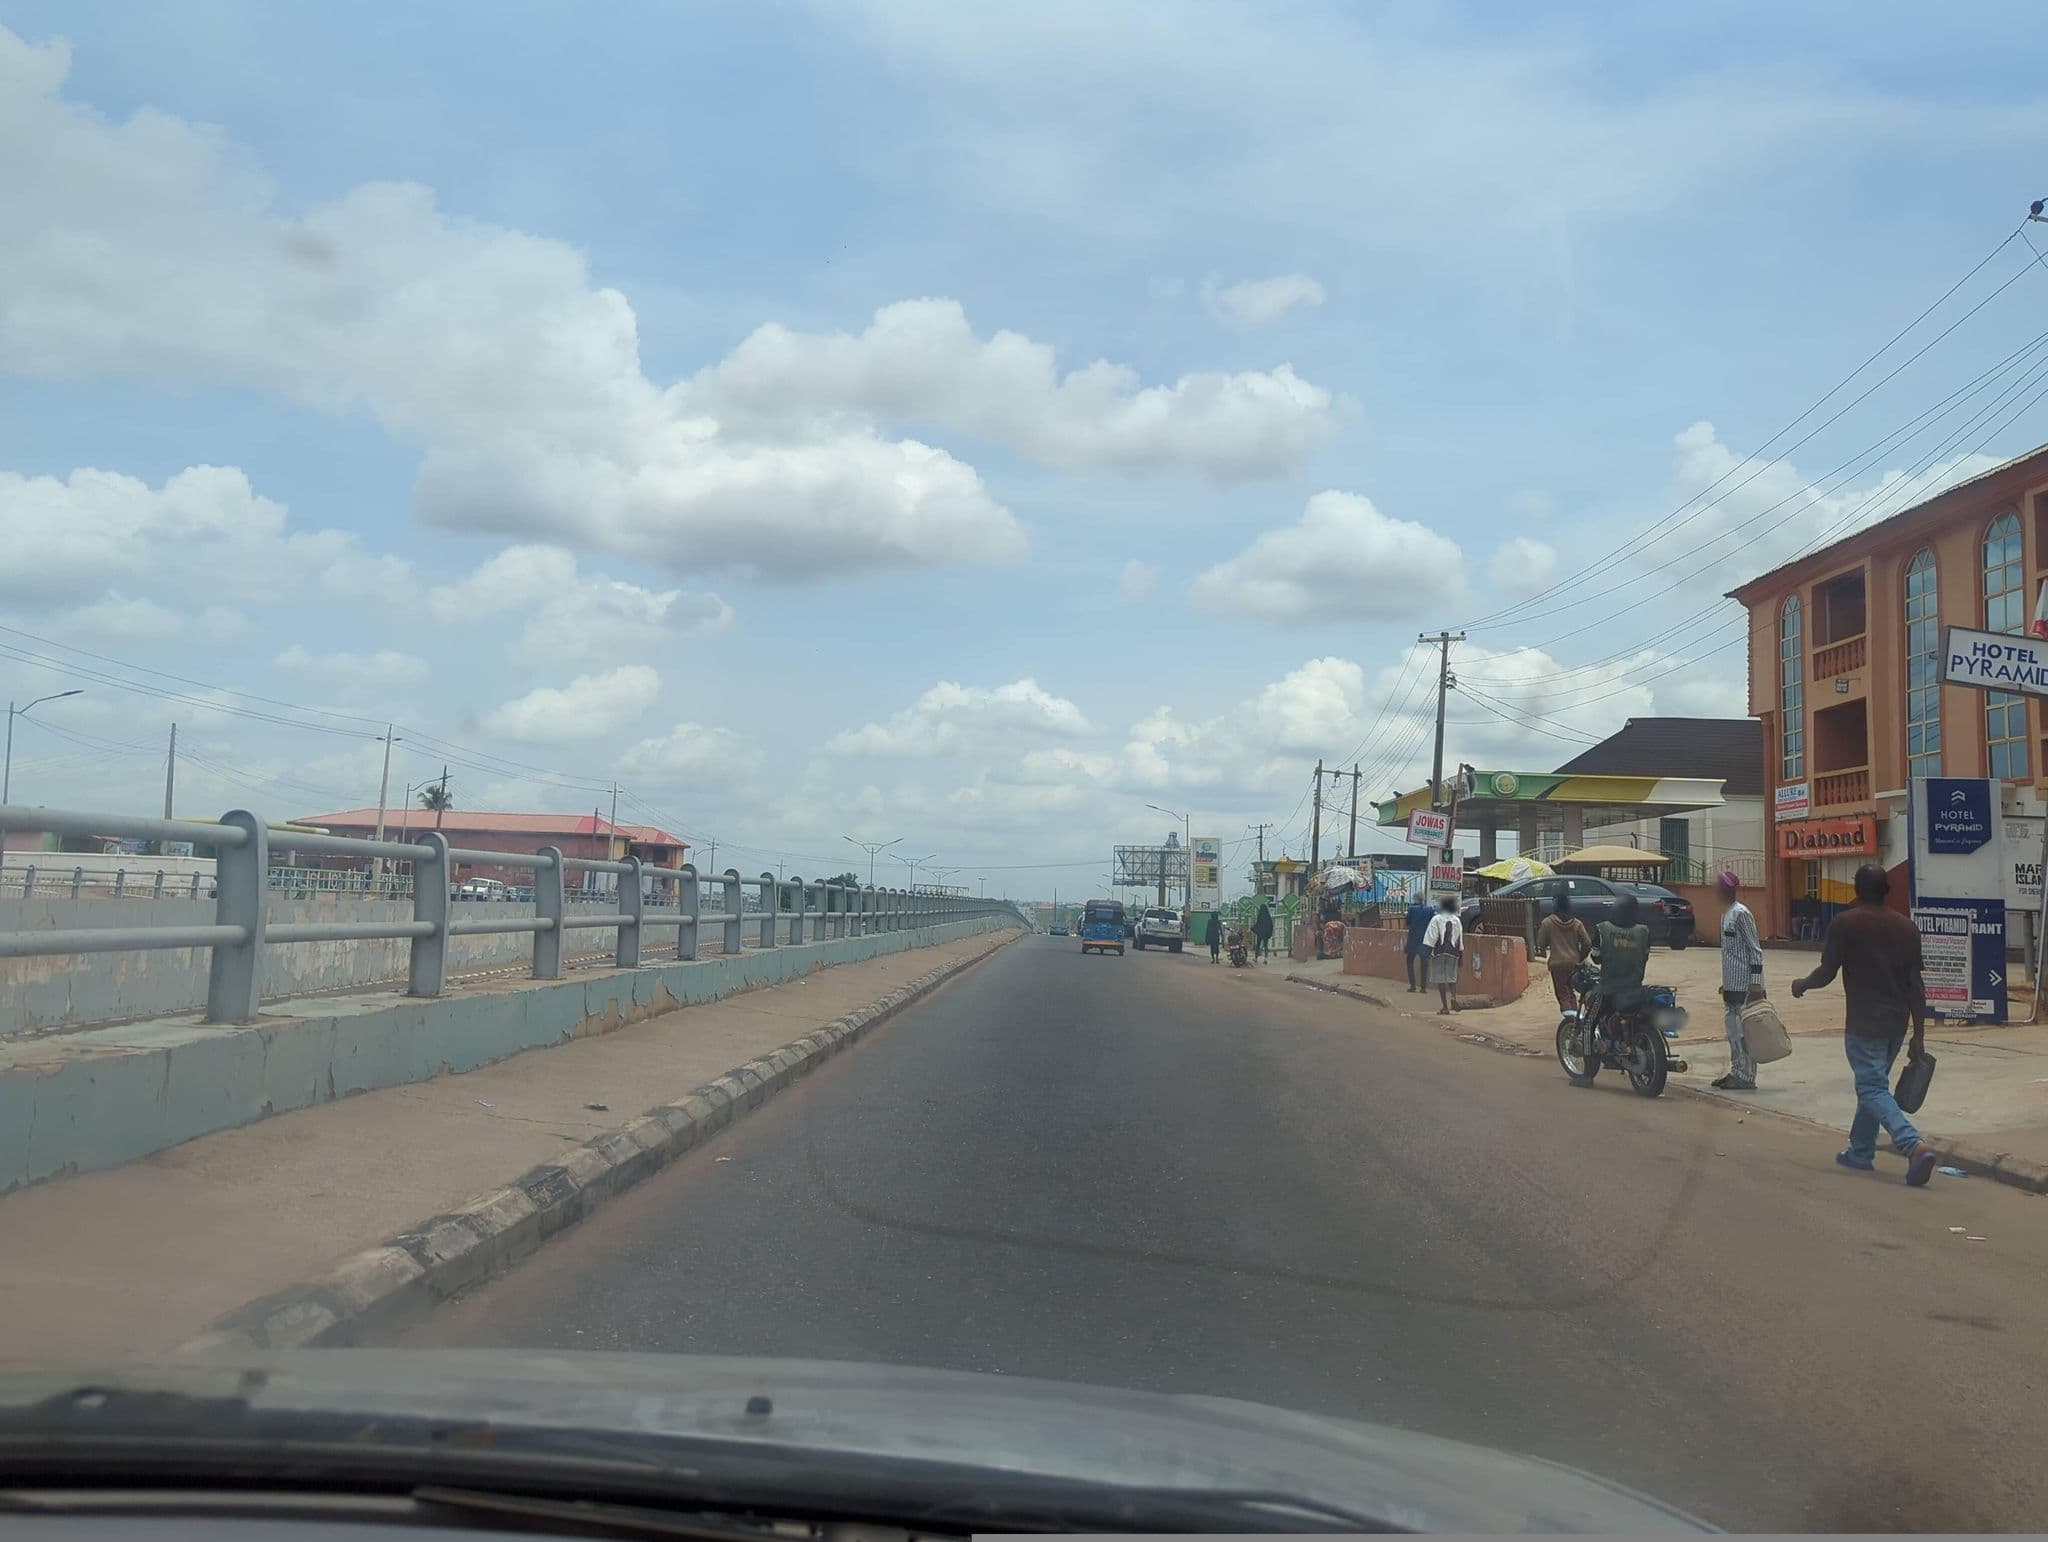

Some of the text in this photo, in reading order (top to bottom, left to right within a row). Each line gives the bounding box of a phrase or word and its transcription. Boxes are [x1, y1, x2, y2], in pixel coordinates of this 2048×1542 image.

[1972, 642, 2038, 664] HOTEL
[1416, 815, 1444, 829] JOWAS
[1941, 810, 1975, 820] HOTEL
[1935, 823, 1983, 833] PYRAMID
[1785, 824, 1867, 850] Diabond
[1432, 866, 1462, 881] JOWAS
[1935, 917, 1967, 934] PYRAMID
